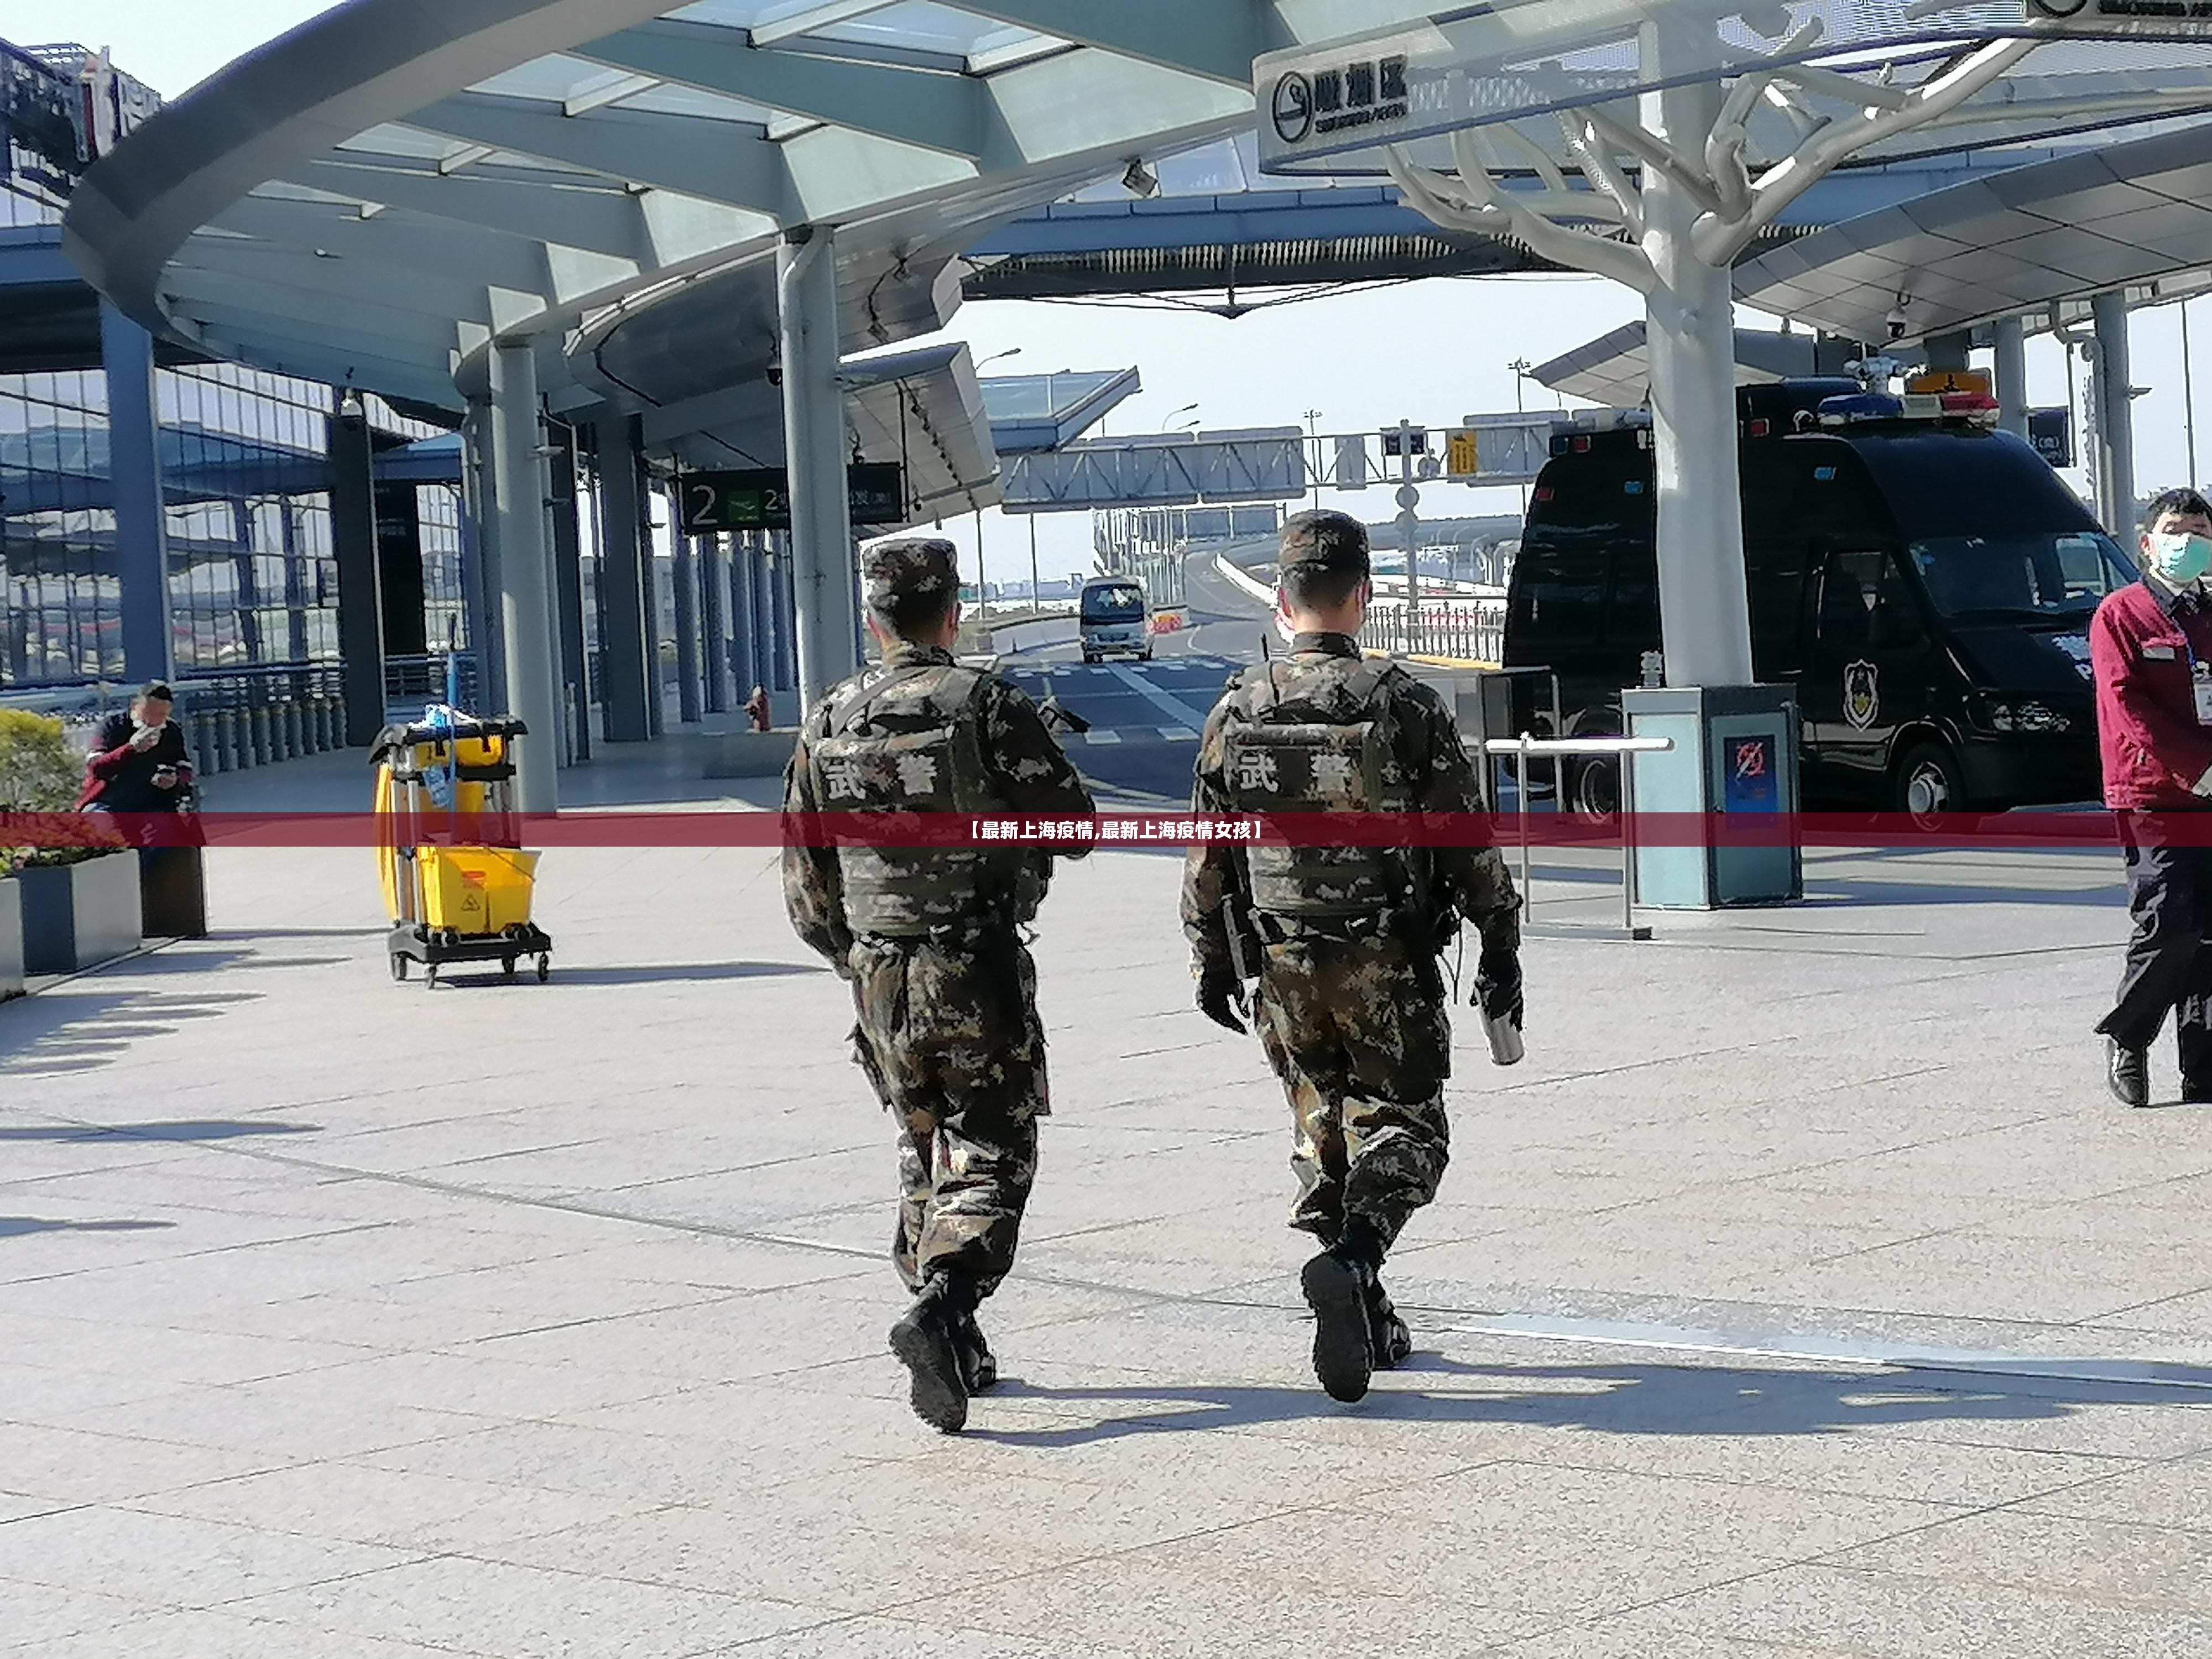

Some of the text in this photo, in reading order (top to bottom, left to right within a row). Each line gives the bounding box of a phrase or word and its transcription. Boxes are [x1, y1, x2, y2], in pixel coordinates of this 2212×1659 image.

[692, 484, 718, 525] 2
[825, 754, 938, 800] 武警
[1239, 753, 1352, 792] 武警
